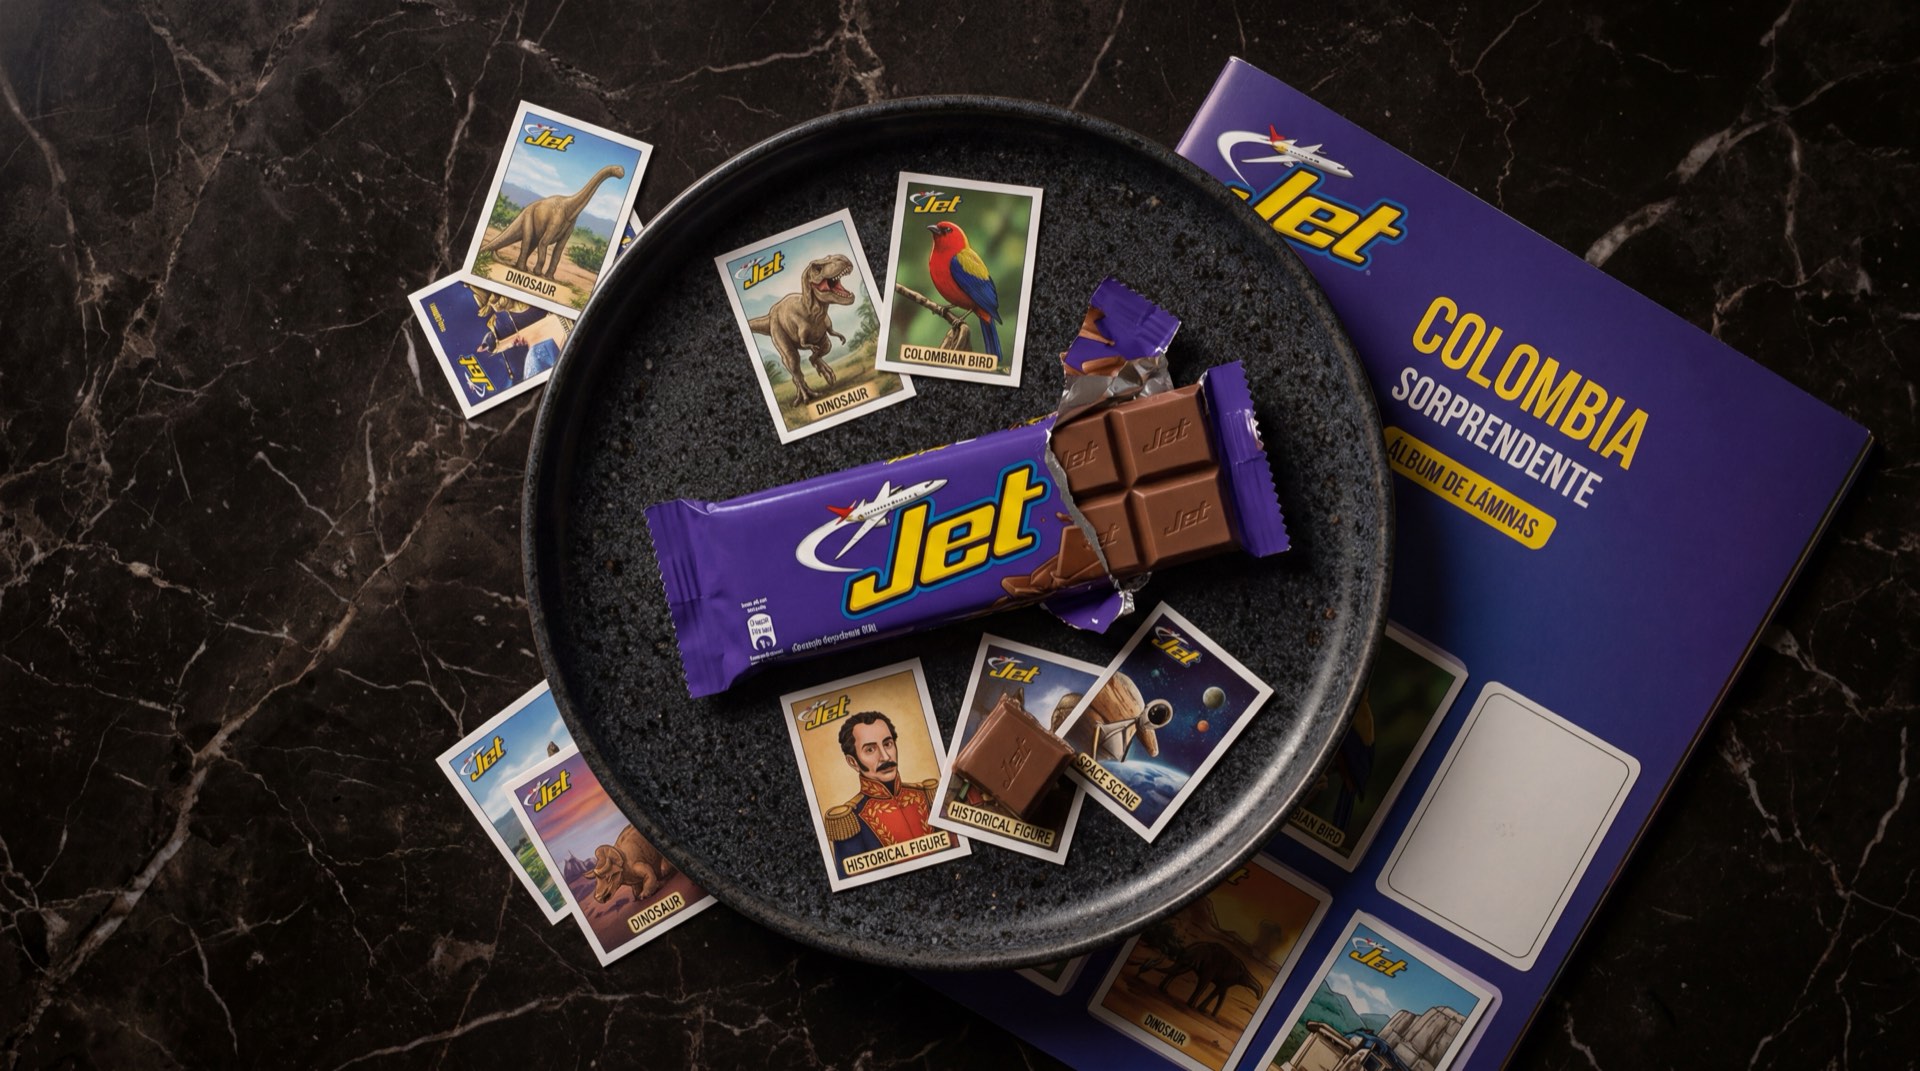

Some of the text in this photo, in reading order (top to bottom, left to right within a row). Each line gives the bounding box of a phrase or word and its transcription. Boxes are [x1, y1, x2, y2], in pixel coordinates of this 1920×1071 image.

[524, 130, 575, 152] Jet
[914, 194, 962, 213] Jet
[505, 270, 557, 297] DINOSAUR
[743, 250, 785, 290] Jet
[458, 353, 495, 392] Jet
[903, 347, 994, 369] COLOMBIAN BIRD
[816, 387, 869, 416] DINOSAUR
[1412, 296, 1649, 471] COLOMBIA
[1142, 418, 1191, 454] Jet
[1392, 367, 1603, 509] SORPRENDENTE
[1389, 433, 1539, 539] ÁLBUM DE LÁMINAS
[1163, 500, 1212, 537] Jet
[847, 465, 1046, 614] Jet
[1151, 635, 1202, 668] Jet
[989, 661, 1041, 684] Jet
[805, 695, 850, 730] Jet
[470, 735, 506, 782] Jet
[534, 769, 572, 812] Jet
[1076, 755, 1139, 808] SPACE SCENE
[950, 804, 1052, 845] HISTORICAL FIGURE
[1316, 823, 1342, 844] BIRD
[846, 833, 949, 873] HISTORICAL FIGURE
[630, 894, 682, 931] DINOSAUR
[1348, 947, 1409, 979] Jet
[1144, 1014, 1186, 1046] DINOSAUR
